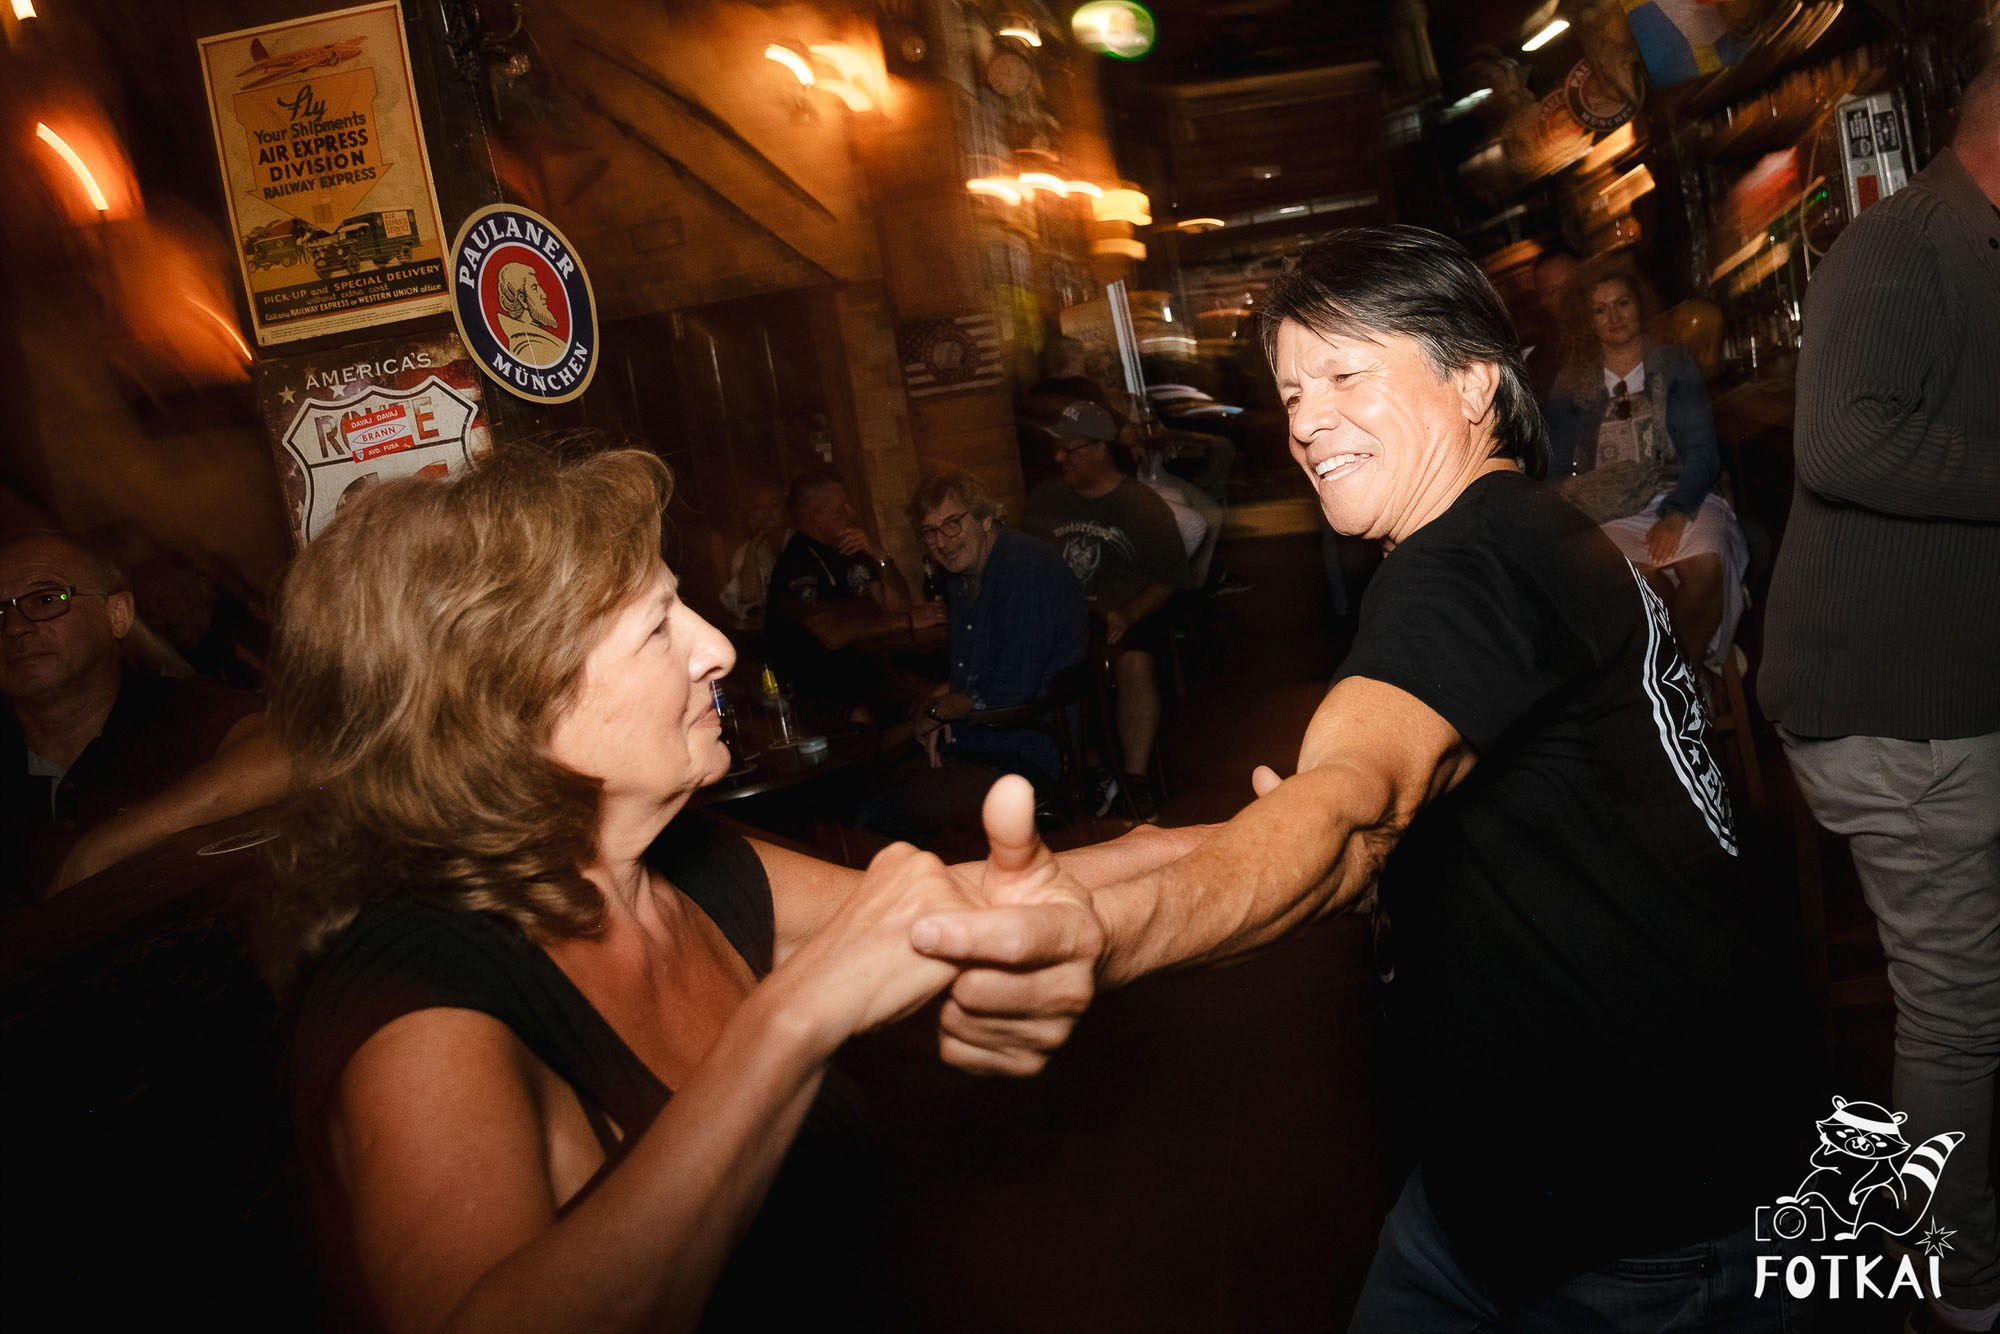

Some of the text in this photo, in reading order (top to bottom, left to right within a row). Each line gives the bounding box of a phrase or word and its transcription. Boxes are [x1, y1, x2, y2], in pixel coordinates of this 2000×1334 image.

[277, 84, 328, 122] Fly
[253, 111, 367, 145] Your Shipments
[259, 128, 369, 165] AIR EXPRESS
[263, 166, 377, 200] RAILWAY EXPRESS
[269, 150, 366, 182] DIVISION
[459, 216, 575, 288] PAULANER
[264, 264, 440, 304] PICK-UP and SPECIAL DELIVERY
[290, 305, 319, 316] RAILWAY
[320, 299, 349, 311] EXPRESS
[357, 291, 392, 303] WESTERN
[393, 286, 419, 297] UNION
[420, 284, 442, 293] office
[305, 352, 432, 391] AMERICA'S
[492, 341, 589, 391] MÜNCHEN
[314, 396, 440, 459] ROE
[351, 409, 398, 429] DAVAJ DAVAJ
[361, 426, 396, 442] BRANN
